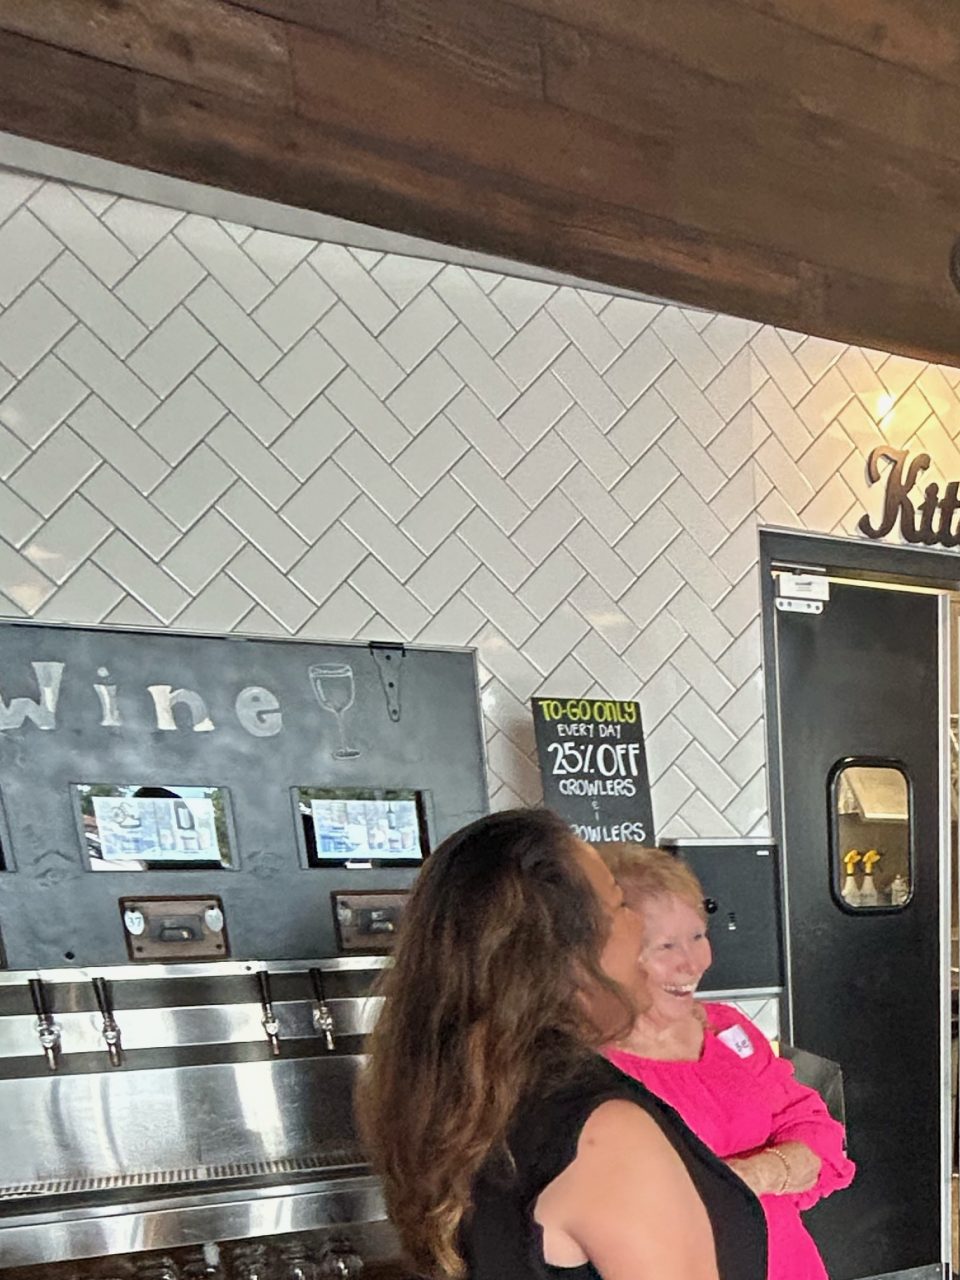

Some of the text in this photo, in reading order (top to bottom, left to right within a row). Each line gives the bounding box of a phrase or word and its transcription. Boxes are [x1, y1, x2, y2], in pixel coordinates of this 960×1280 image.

[0, 661, 283, 737] Wine
[539, 700, 637, 723] TO-GO ONLY
[557, 723, 621, 739] EVERY DAY
[547, 742, 640, 777] 25% OFF
[559, 779, 636, 797] CROWLERS
[568, 822, 646, 843] ROWLERS
